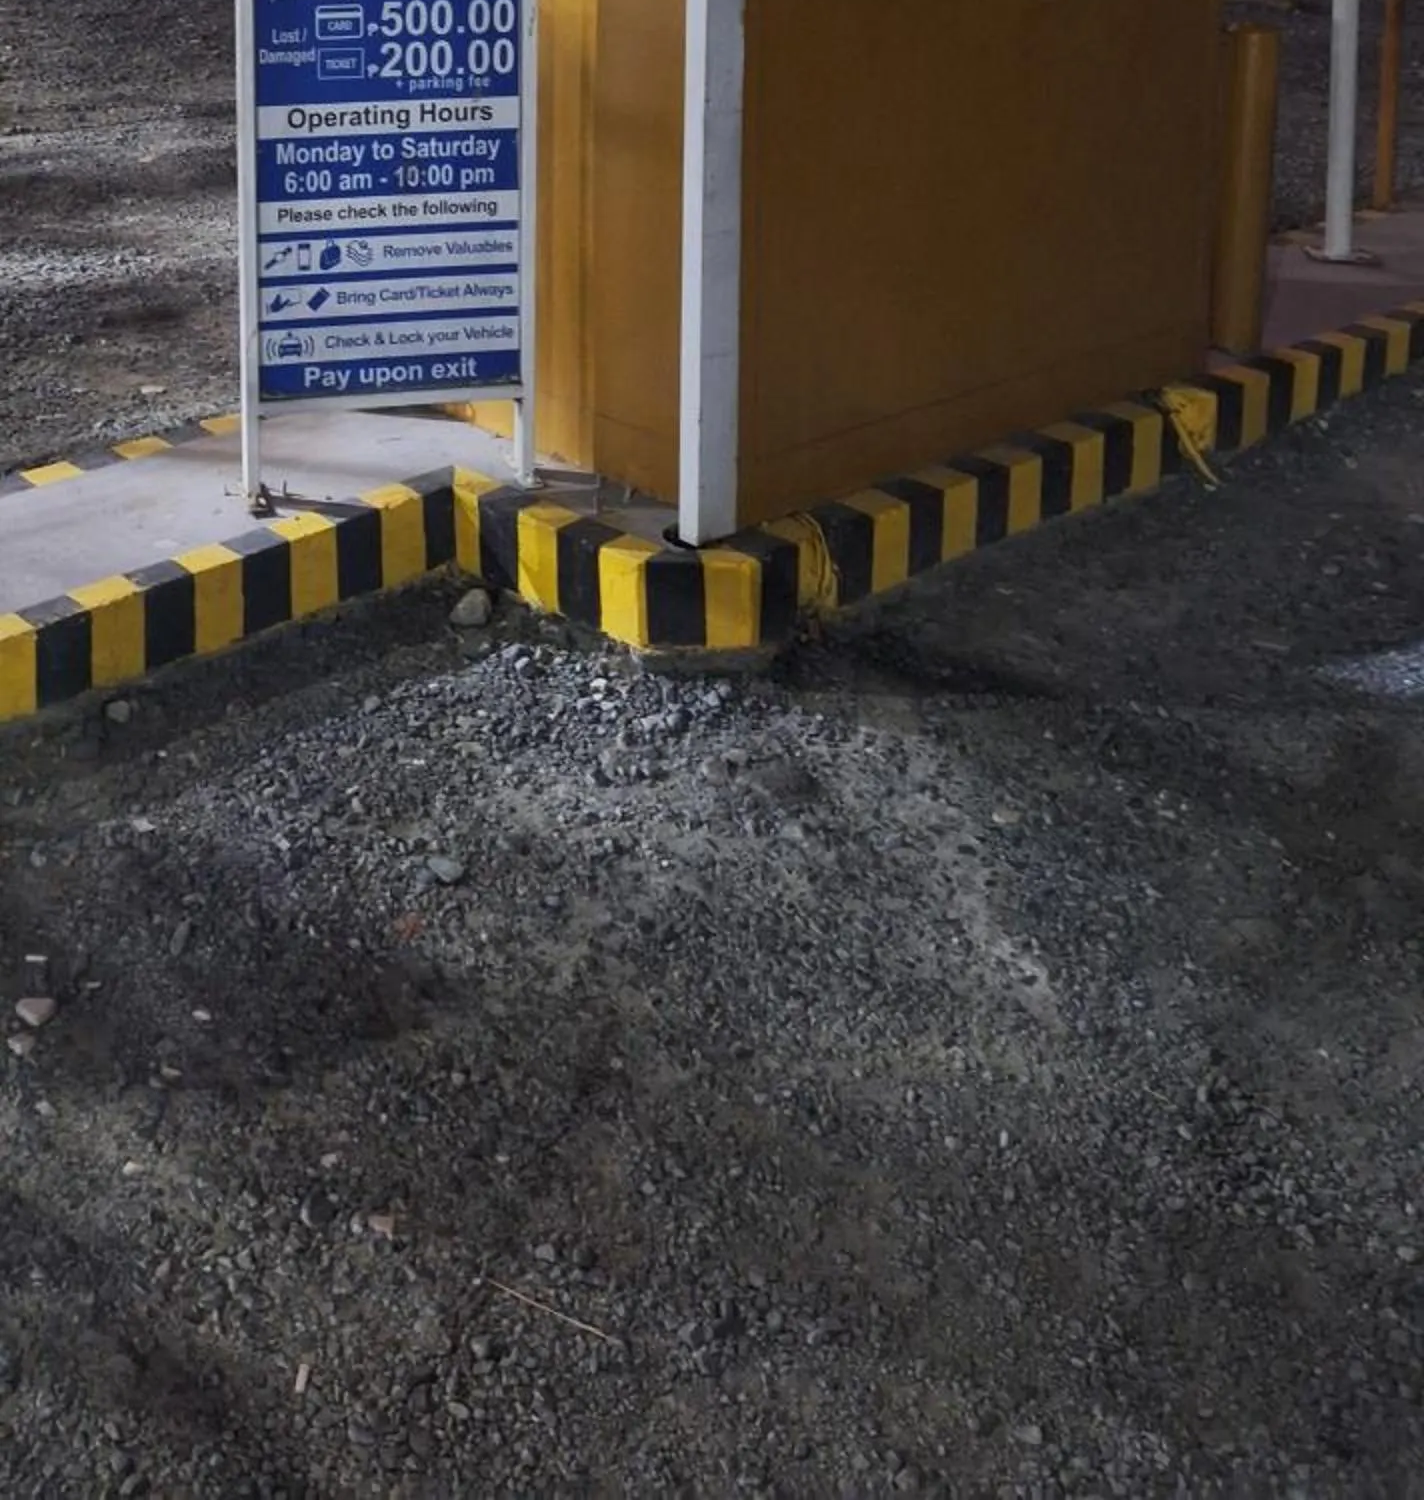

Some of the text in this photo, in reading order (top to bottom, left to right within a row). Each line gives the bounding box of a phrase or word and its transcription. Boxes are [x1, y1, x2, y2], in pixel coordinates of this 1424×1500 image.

[327, 20, 353, 31] CARD
[259, 48, 315, 67] Damaged
[325, 58, 357, 69] TICKET
[409, 75, 464, 93] parking
[468, 75, 491, 88] fee
[287, 103, 494, 133] Operating Hours
[276, 136, 501, 167] Monday to Saturday
[284, 170, 332, 194] 6:00
[338, 172, 373, 190] am
[395, 164, 454, 188] 10:00
[460, 166, 495, 188] pm
[277, 196, 498, 224] Please check the following
[382, 238, 514, 259] Remove Valuables
[336, 282, 514, 306] Bring Card/Ticket Always
[324, 323, 514, 349] Check & Lock your Vehicle
[303, 356, 477, 391] Pay upon exit
